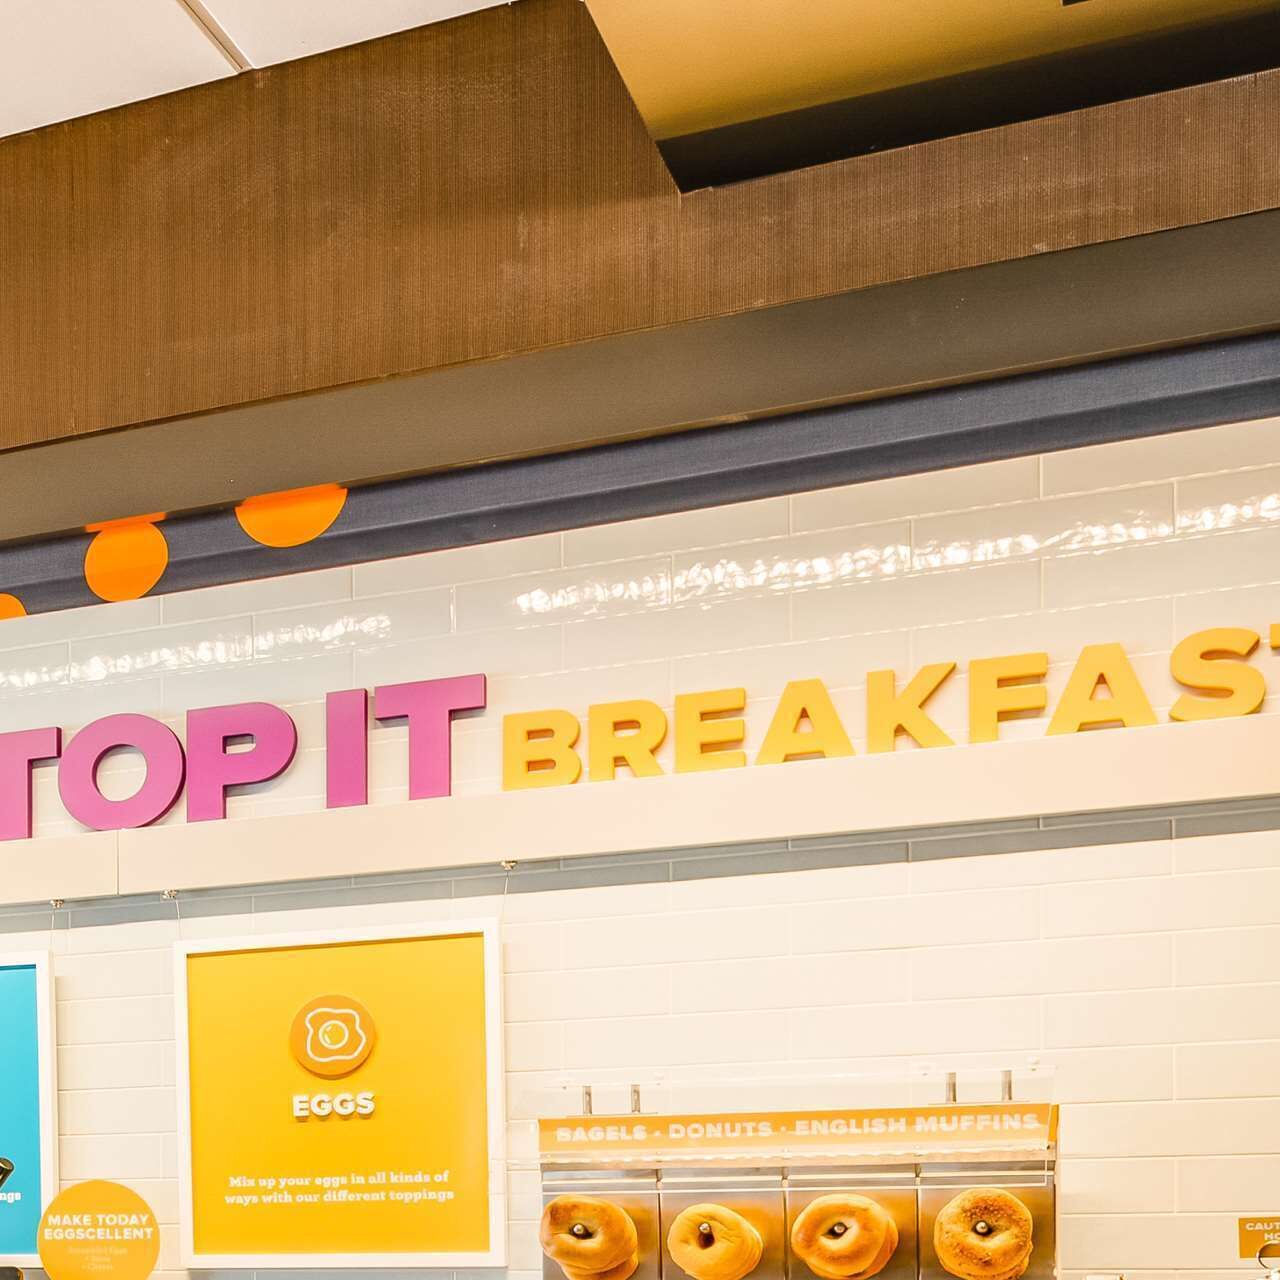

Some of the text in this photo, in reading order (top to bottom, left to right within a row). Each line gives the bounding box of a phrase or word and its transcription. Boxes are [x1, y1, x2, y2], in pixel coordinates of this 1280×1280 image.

[324, 673, 488, 809] IT
[502, 623, 1280, 791] BREAKFAS
[292, 1091, 376, 1119] EGGS
[667, 1120, 773, 1140] DONUTS
[794, 1116, 907, 1137] ENGLISH
[914, 1112, 1040, 1134] MUFFINS
[229, 1169, 449, 1190] Mix up your eggs in all kinds of
[225, 1189, 455, 1206] ways with our different toppings
[47, 1213, 149, 1227] MAKE TODAY
[43, 1226, 154, 1240] EGGSCELLENT
